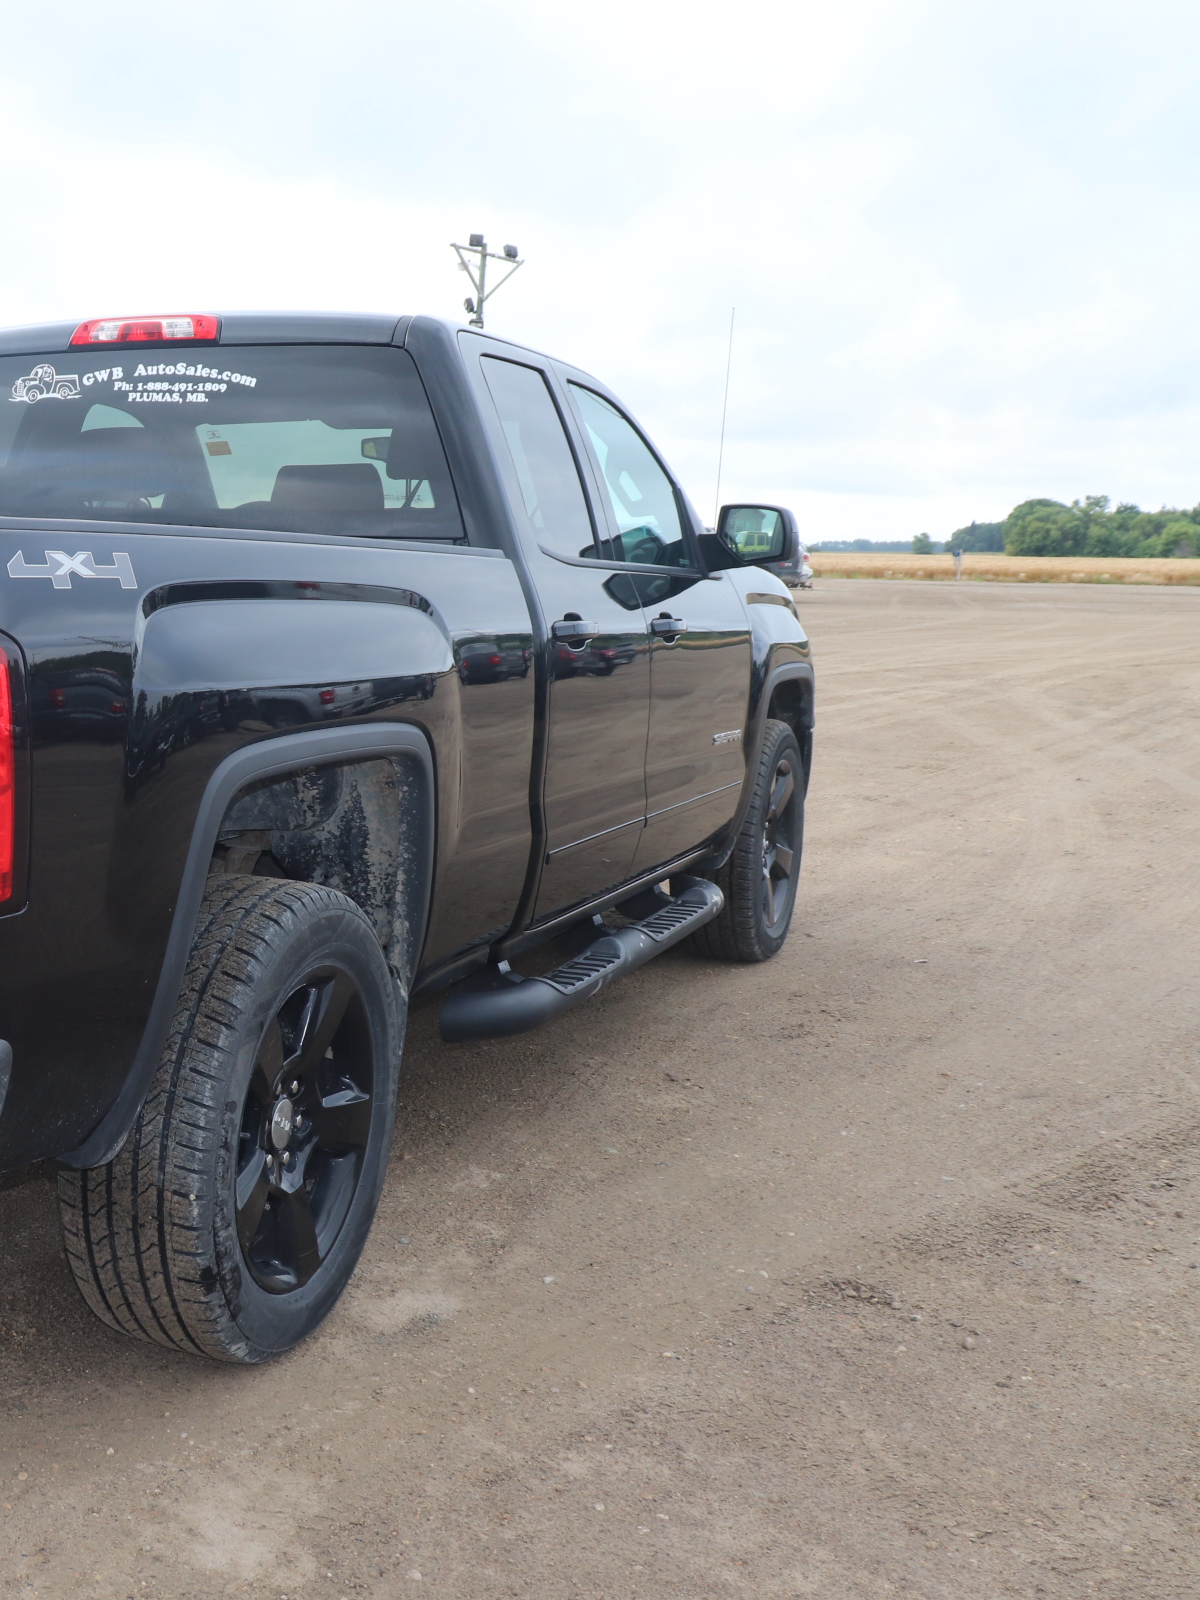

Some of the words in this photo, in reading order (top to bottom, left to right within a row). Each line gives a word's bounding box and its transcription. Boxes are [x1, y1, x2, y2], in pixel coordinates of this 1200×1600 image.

[82, 366, 124, 386] GWB
[133, 362, 258, 388] AutoSales.com
[113, 381, 134, 391] Ph:
[136, 381, 228, 393] 1-888-491-1809
[127, 392, 183, 404] PLUMAS,
[185, 392, 209, 403] MB.
